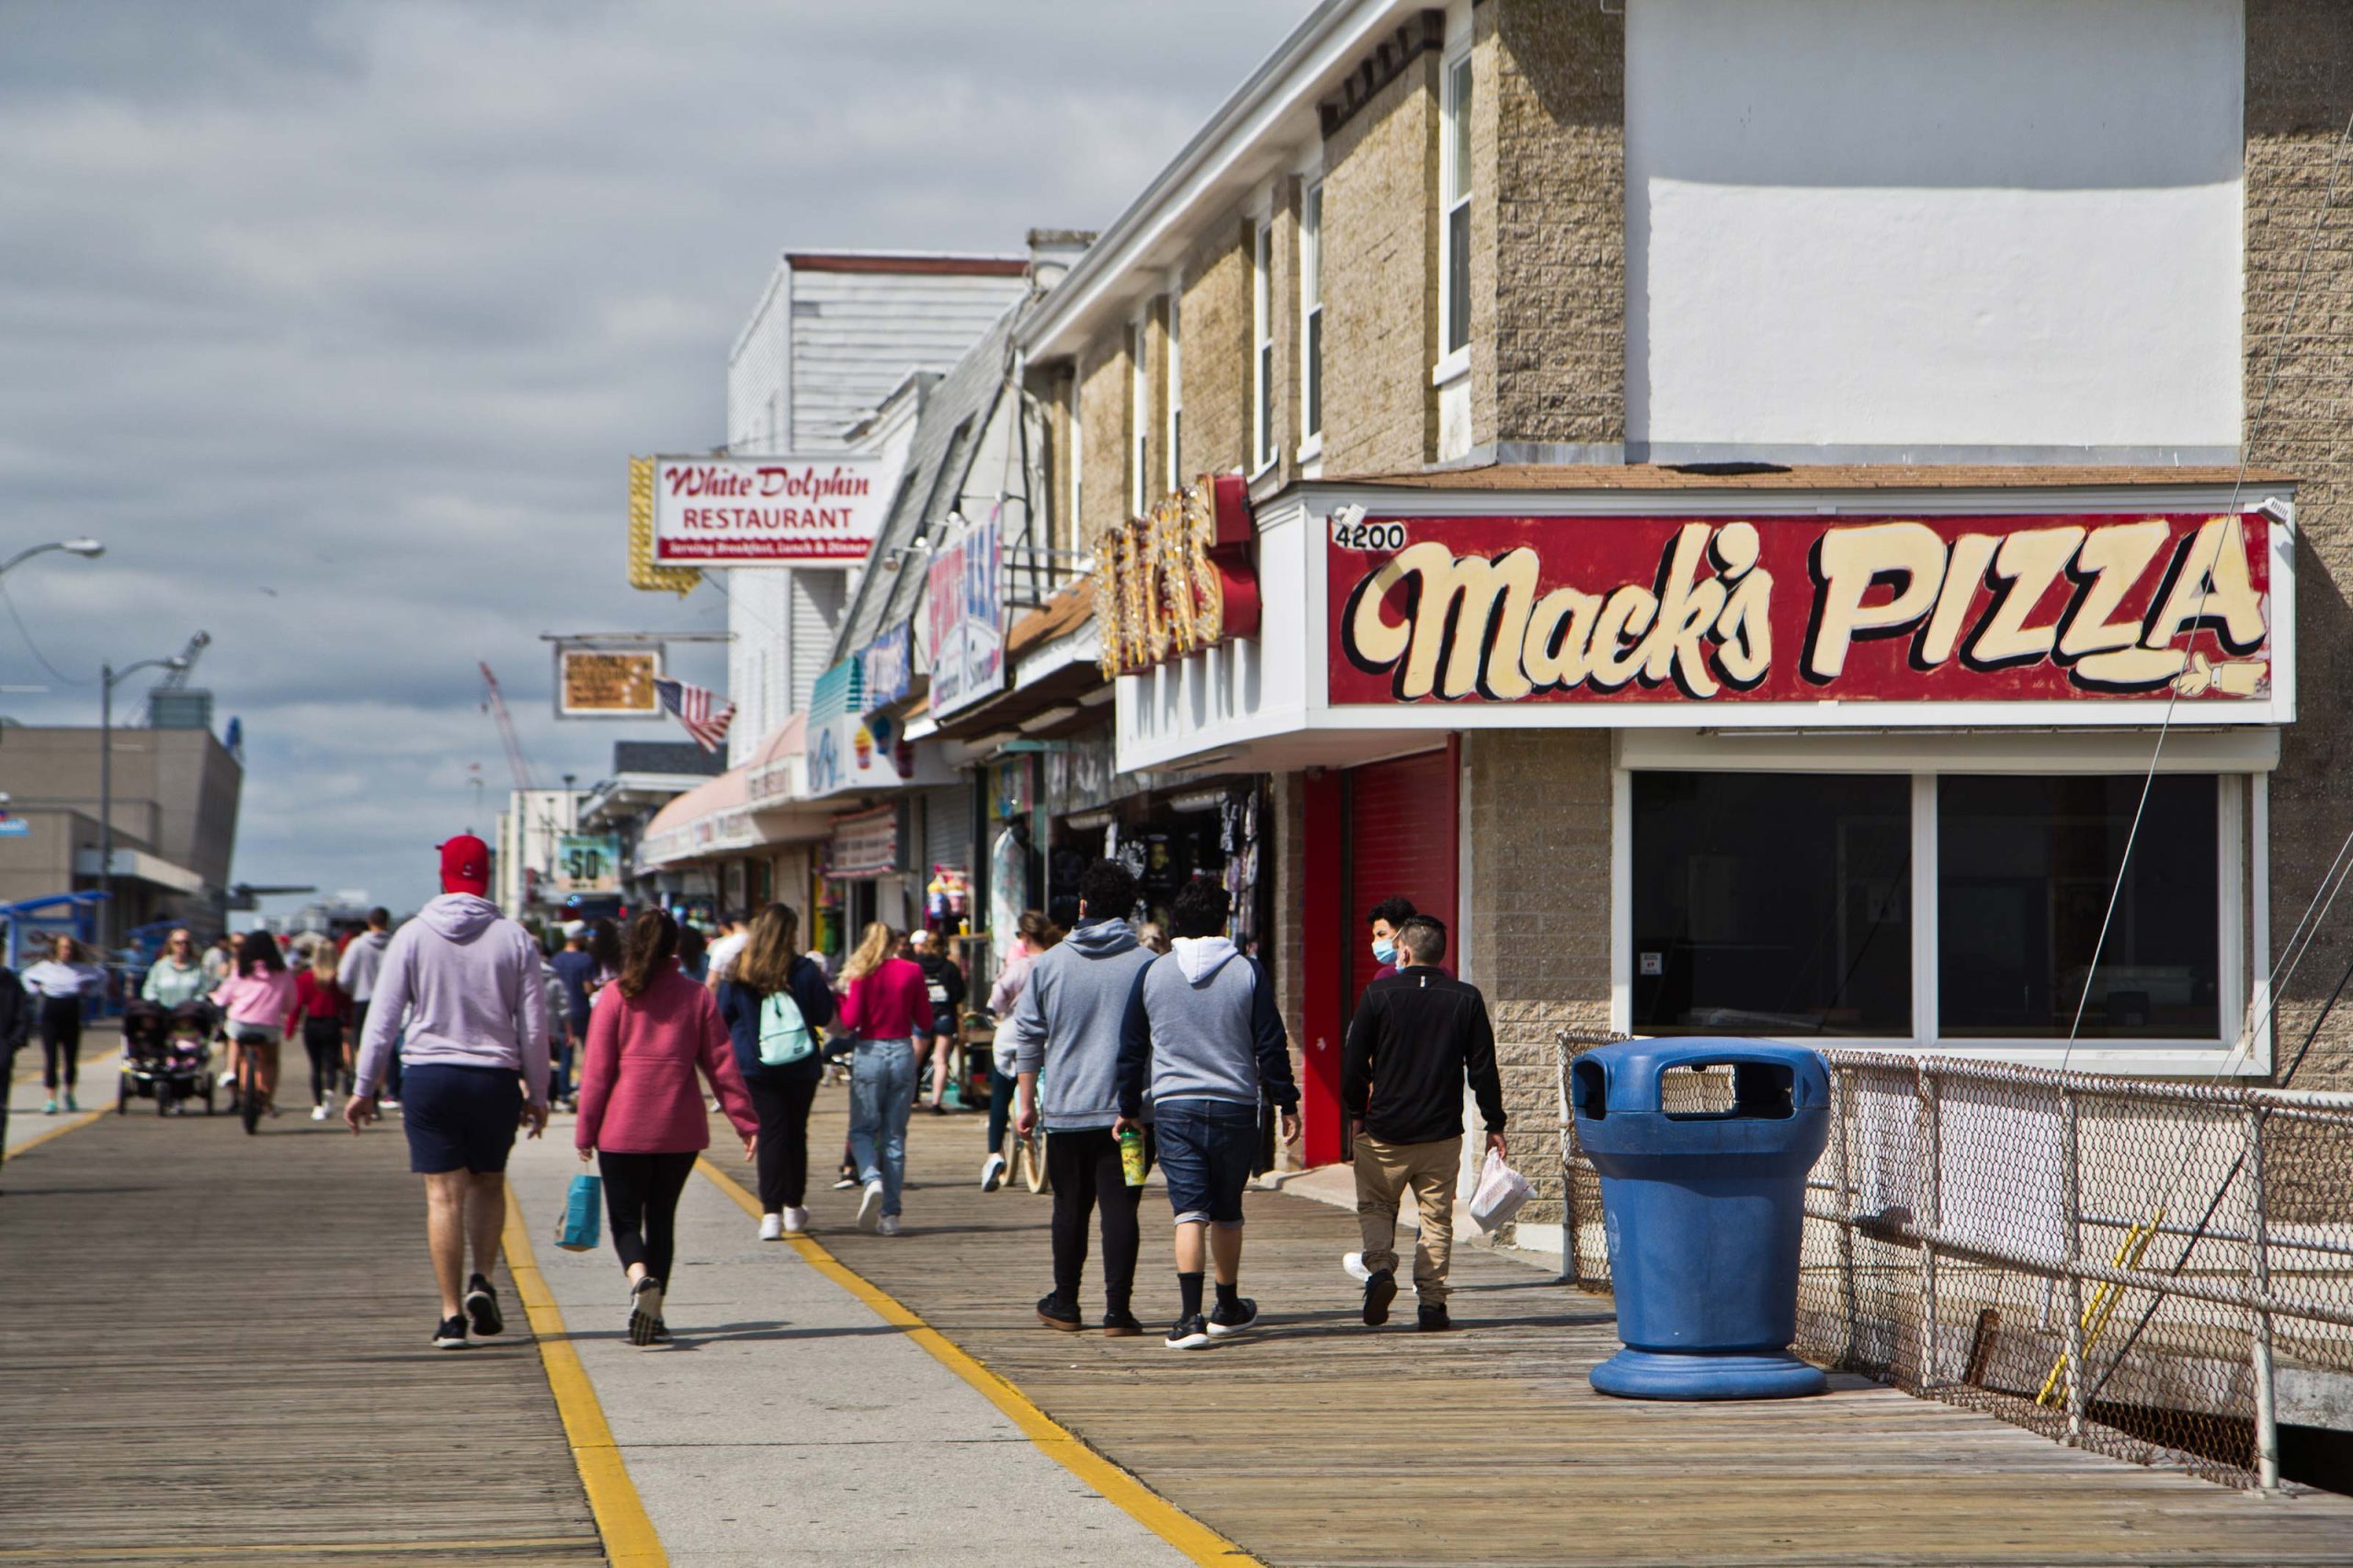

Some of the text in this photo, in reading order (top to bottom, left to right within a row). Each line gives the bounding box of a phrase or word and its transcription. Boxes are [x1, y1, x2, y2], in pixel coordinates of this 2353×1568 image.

[665, 466, 869, 504] White Dolphin
[683, 508, 853, 529] RESTAURANT
[1336, 522, 1404, 550] 4200
[1341, 521, 1775, 701] Mack's
[1799, 515, 2268, 687] PIZZA
